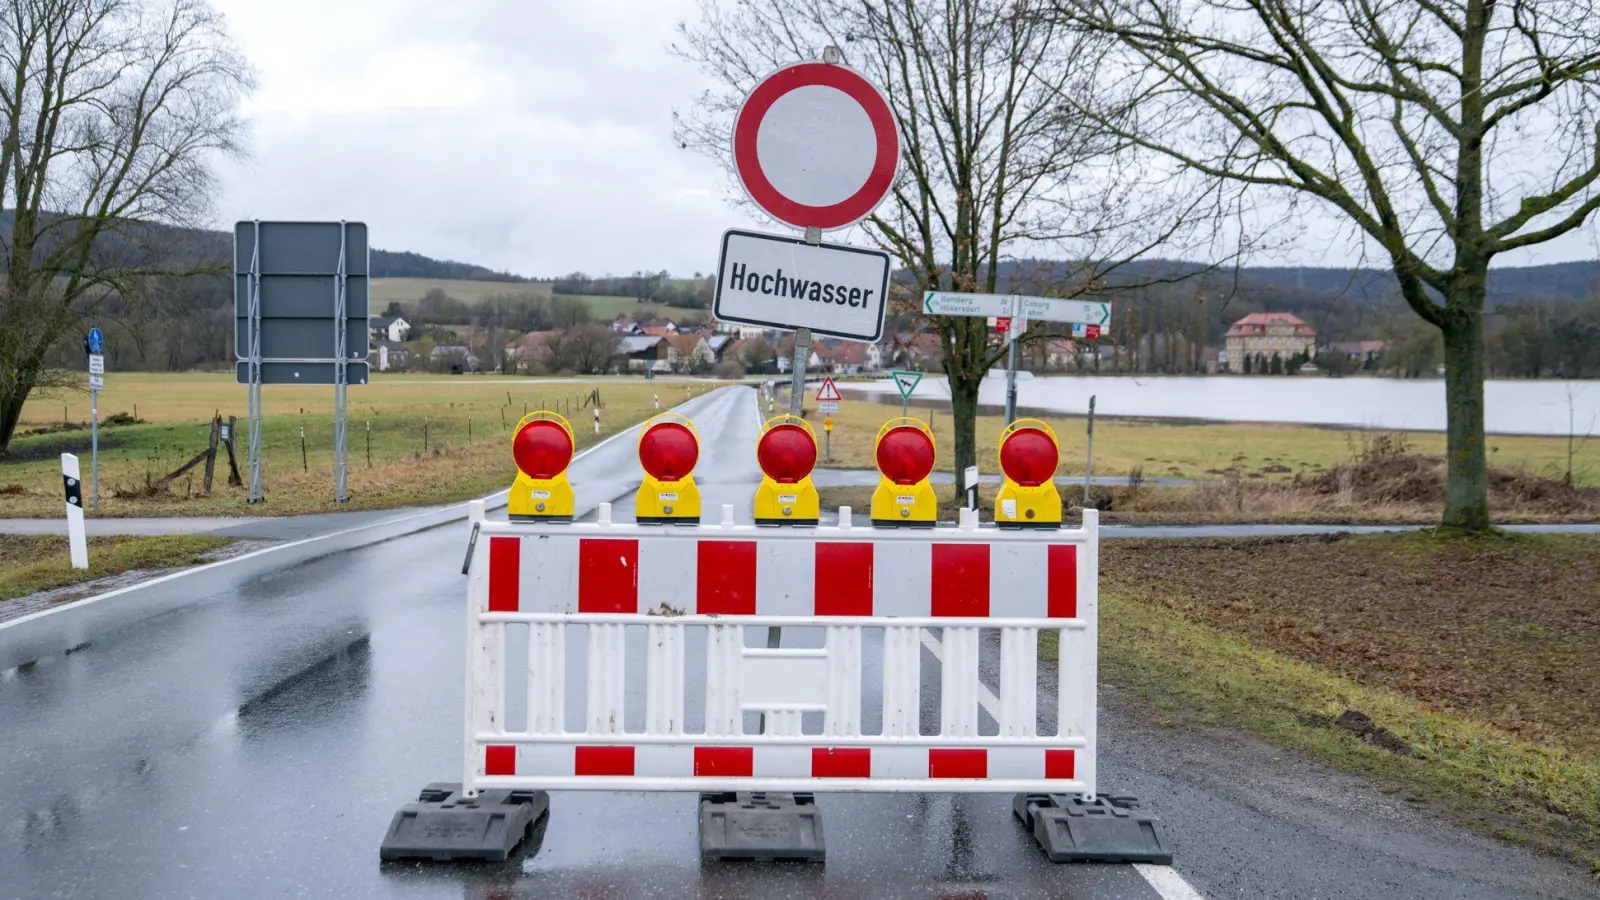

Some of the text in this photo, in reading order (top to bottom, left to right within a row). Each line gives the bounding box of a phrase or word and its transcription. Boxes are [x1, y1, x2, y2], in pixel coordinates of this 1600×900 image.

[730, 262, 874, 309] Hochwasser
[940, 295, 973, 305] Bamberg
[1023, 299, 1050, 310] Coburg
